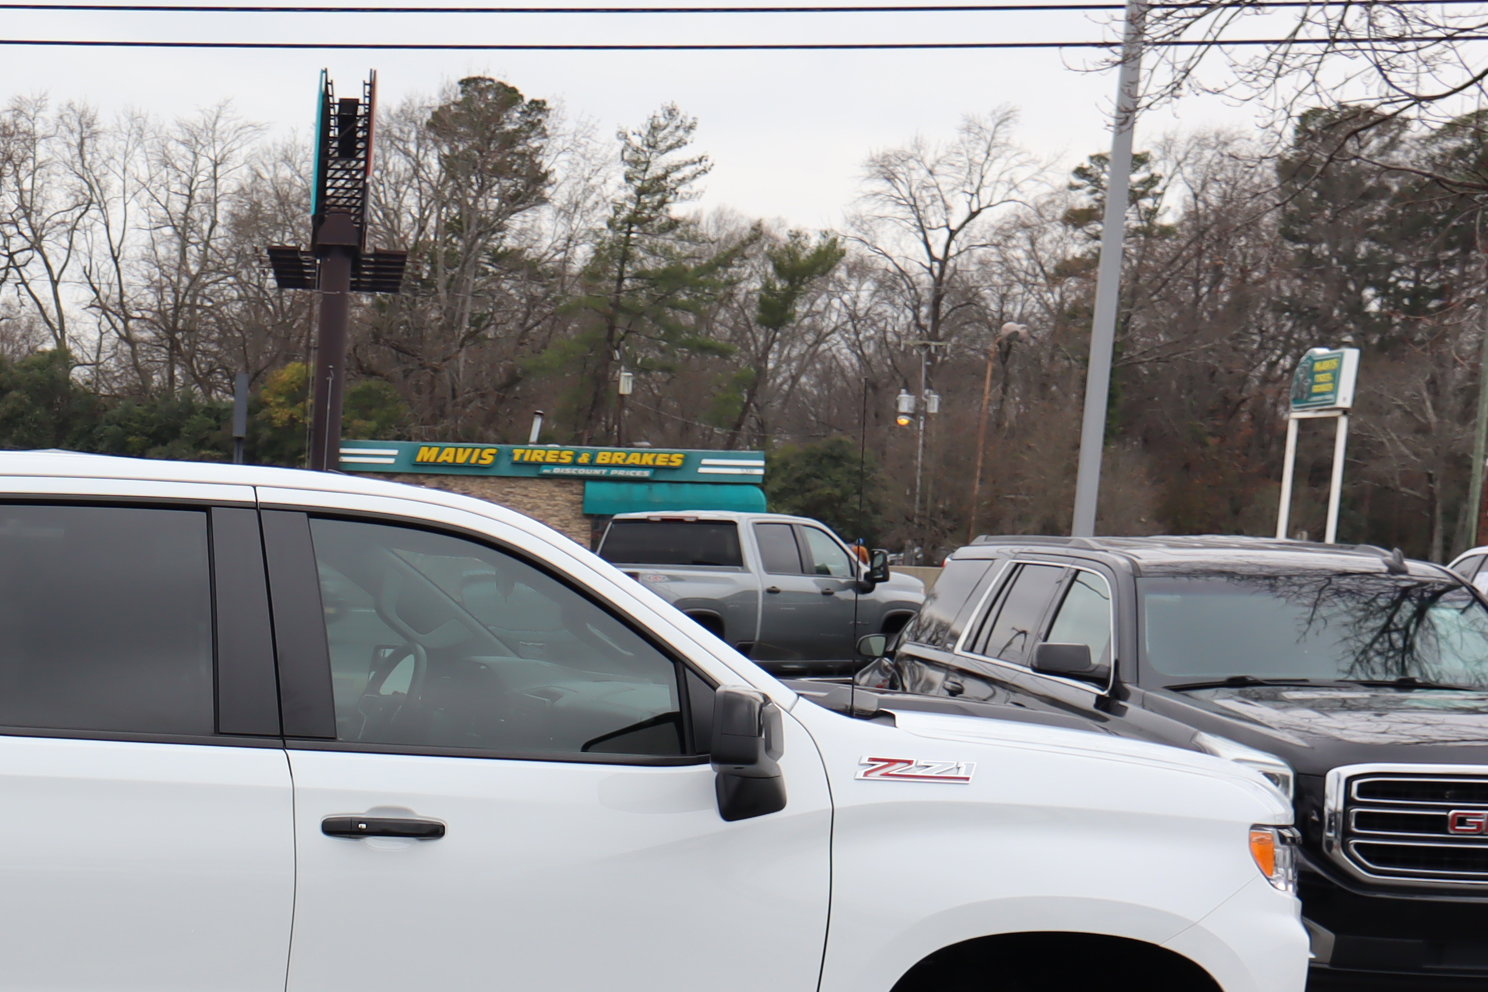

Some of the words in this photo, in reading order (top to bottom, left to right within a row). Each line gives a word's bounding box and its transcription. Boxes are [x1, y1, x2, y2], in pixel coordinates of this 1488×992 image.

[415, 446, 497, 465] MAVIS
[512, 448, 574, 464] TIRES
[577, 452, 591, 464] &
[595, 451, 686, 467] BRAKES
[553, 467, 608, 475] DISCOUNT
[610, 469, 651, 477] PRICES
[854, 755, 976, 785] Z71
[1448, 809, 1488, 834] G
